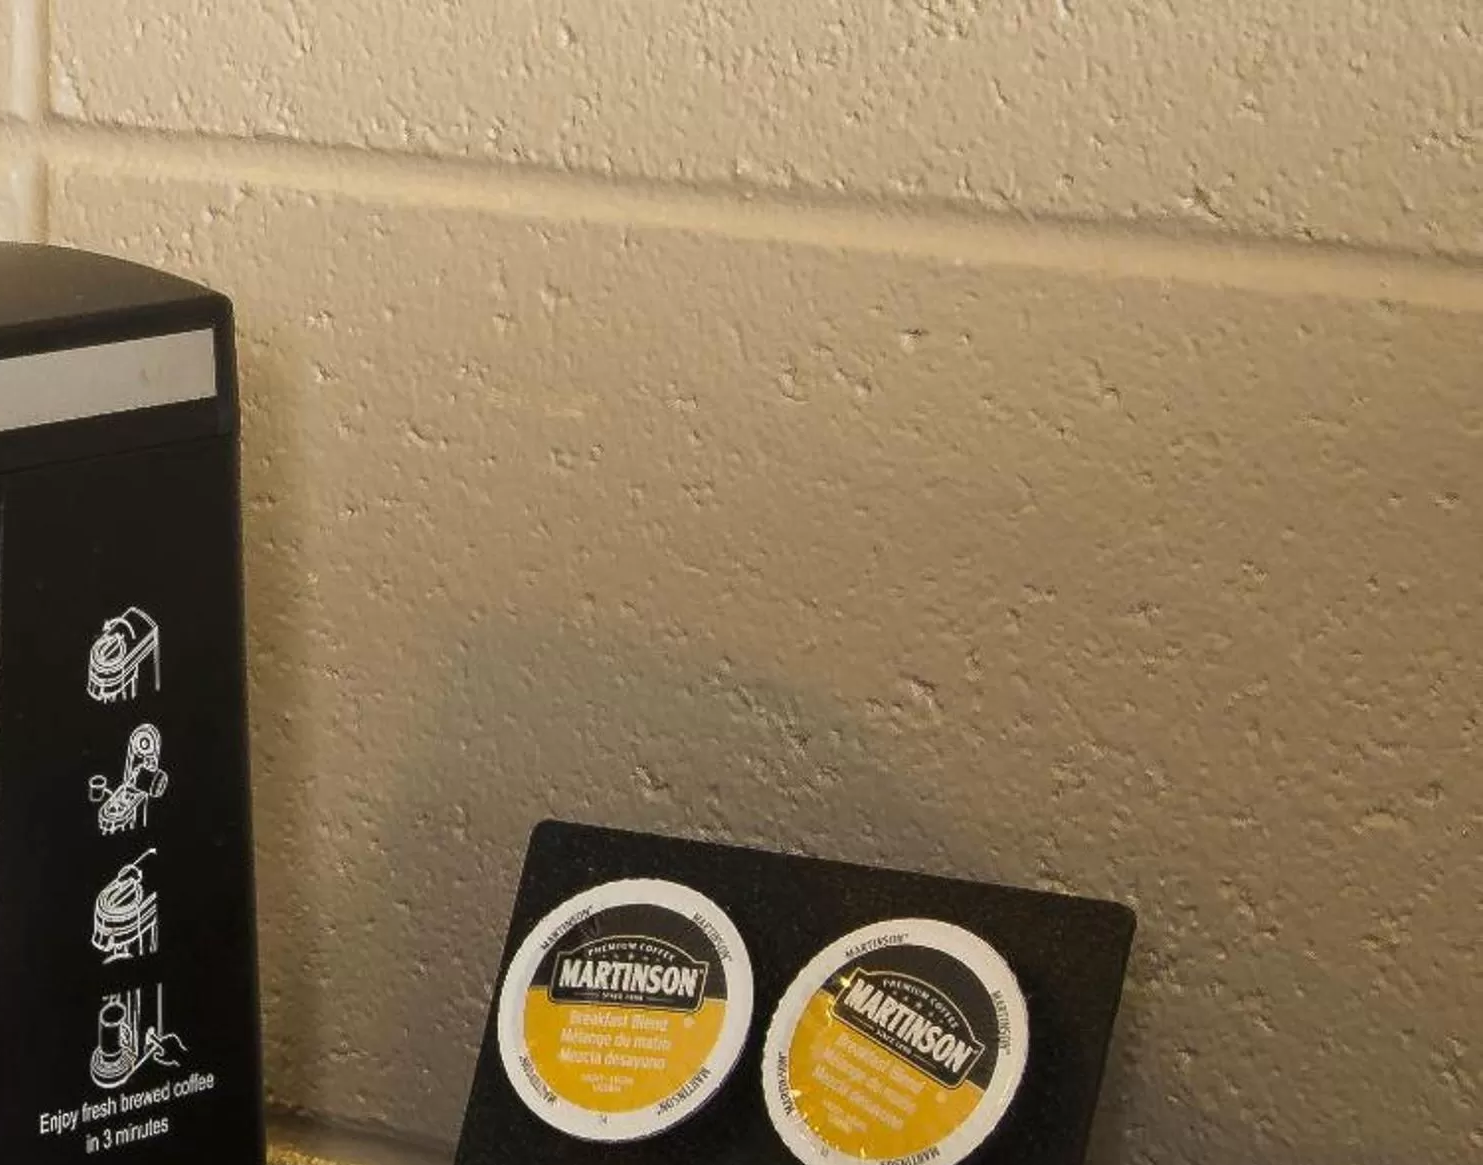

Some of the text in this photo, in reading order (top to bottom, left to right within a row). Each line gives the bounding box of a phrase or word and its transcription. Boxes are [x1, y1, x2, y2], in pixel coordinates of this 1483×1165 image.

[588, 942, 676, 962] PREMIUM COFFEE
[559, 958, 698, 998] MARTINSON
[843, 978, 972, 1074] MARTINSON
[39, 1072, 215, 1135] Enjoy fresh brewed coffee
[85, 1117, 169, 1154] in 3 minutes
